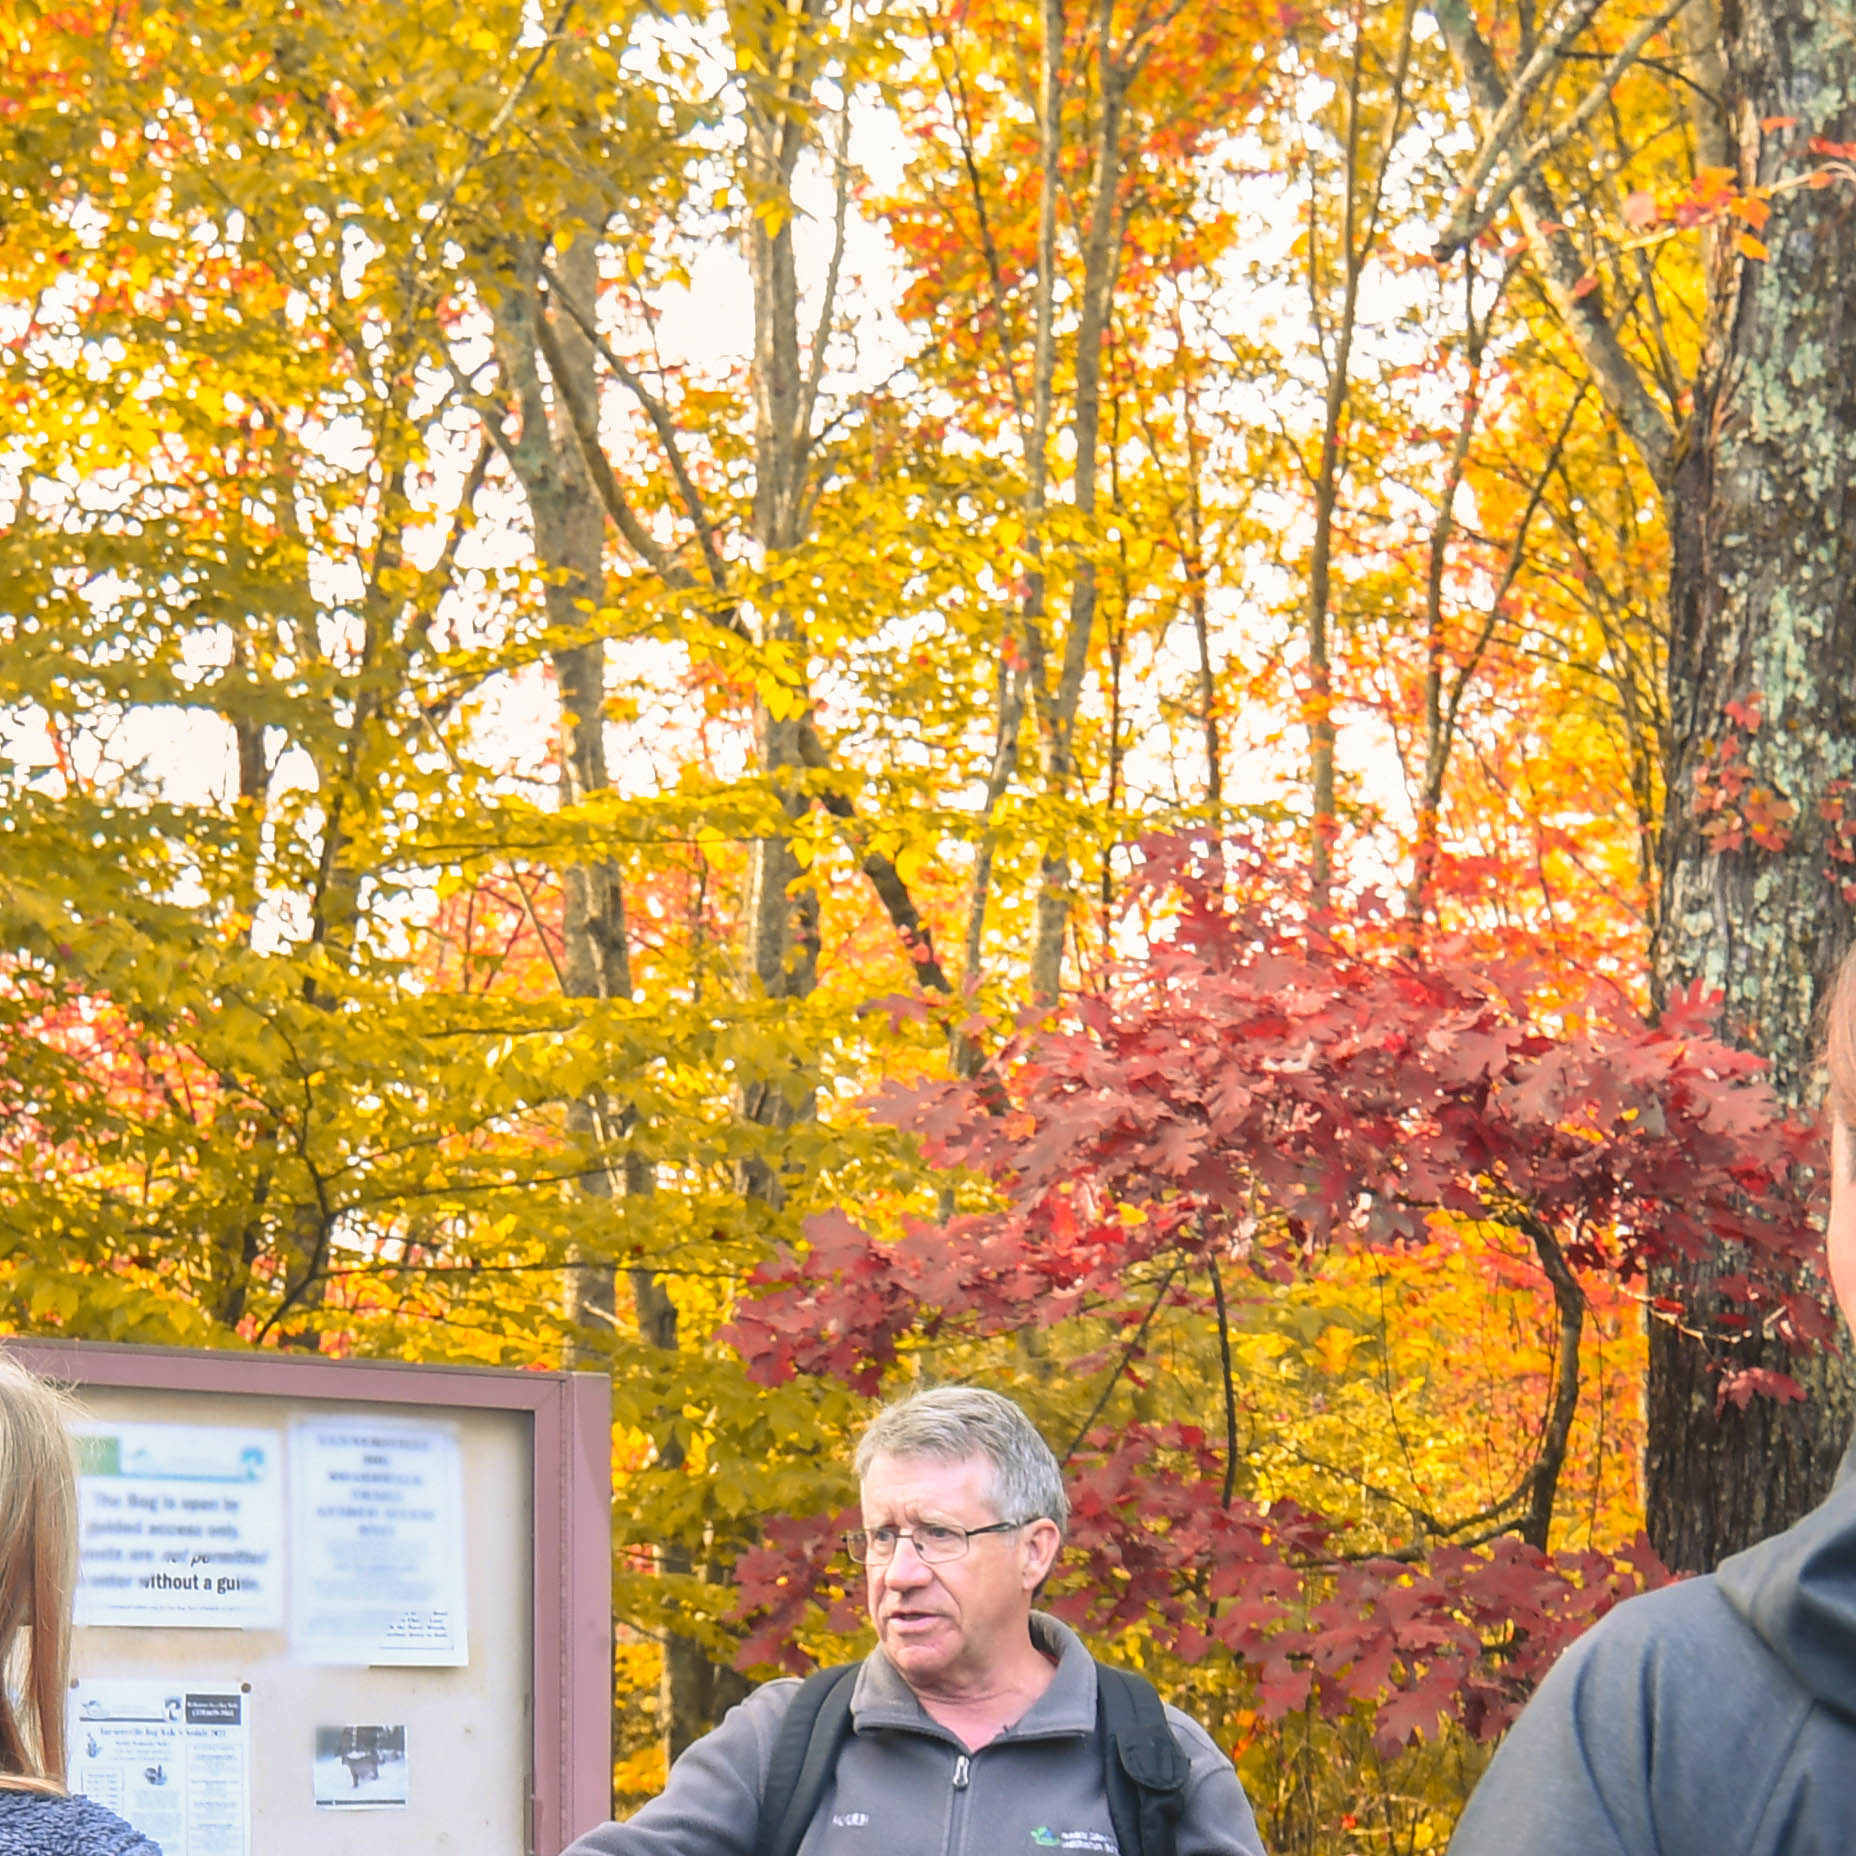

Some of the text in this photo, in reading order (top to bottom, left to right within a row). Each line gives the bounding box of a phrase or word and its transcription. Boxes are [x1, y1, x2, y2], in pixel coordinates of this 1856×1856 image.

[127, 1493, 158, 1513] Bog
[139, 1573, 199, 1590] without
[203, 1577, 213, 1590] a
